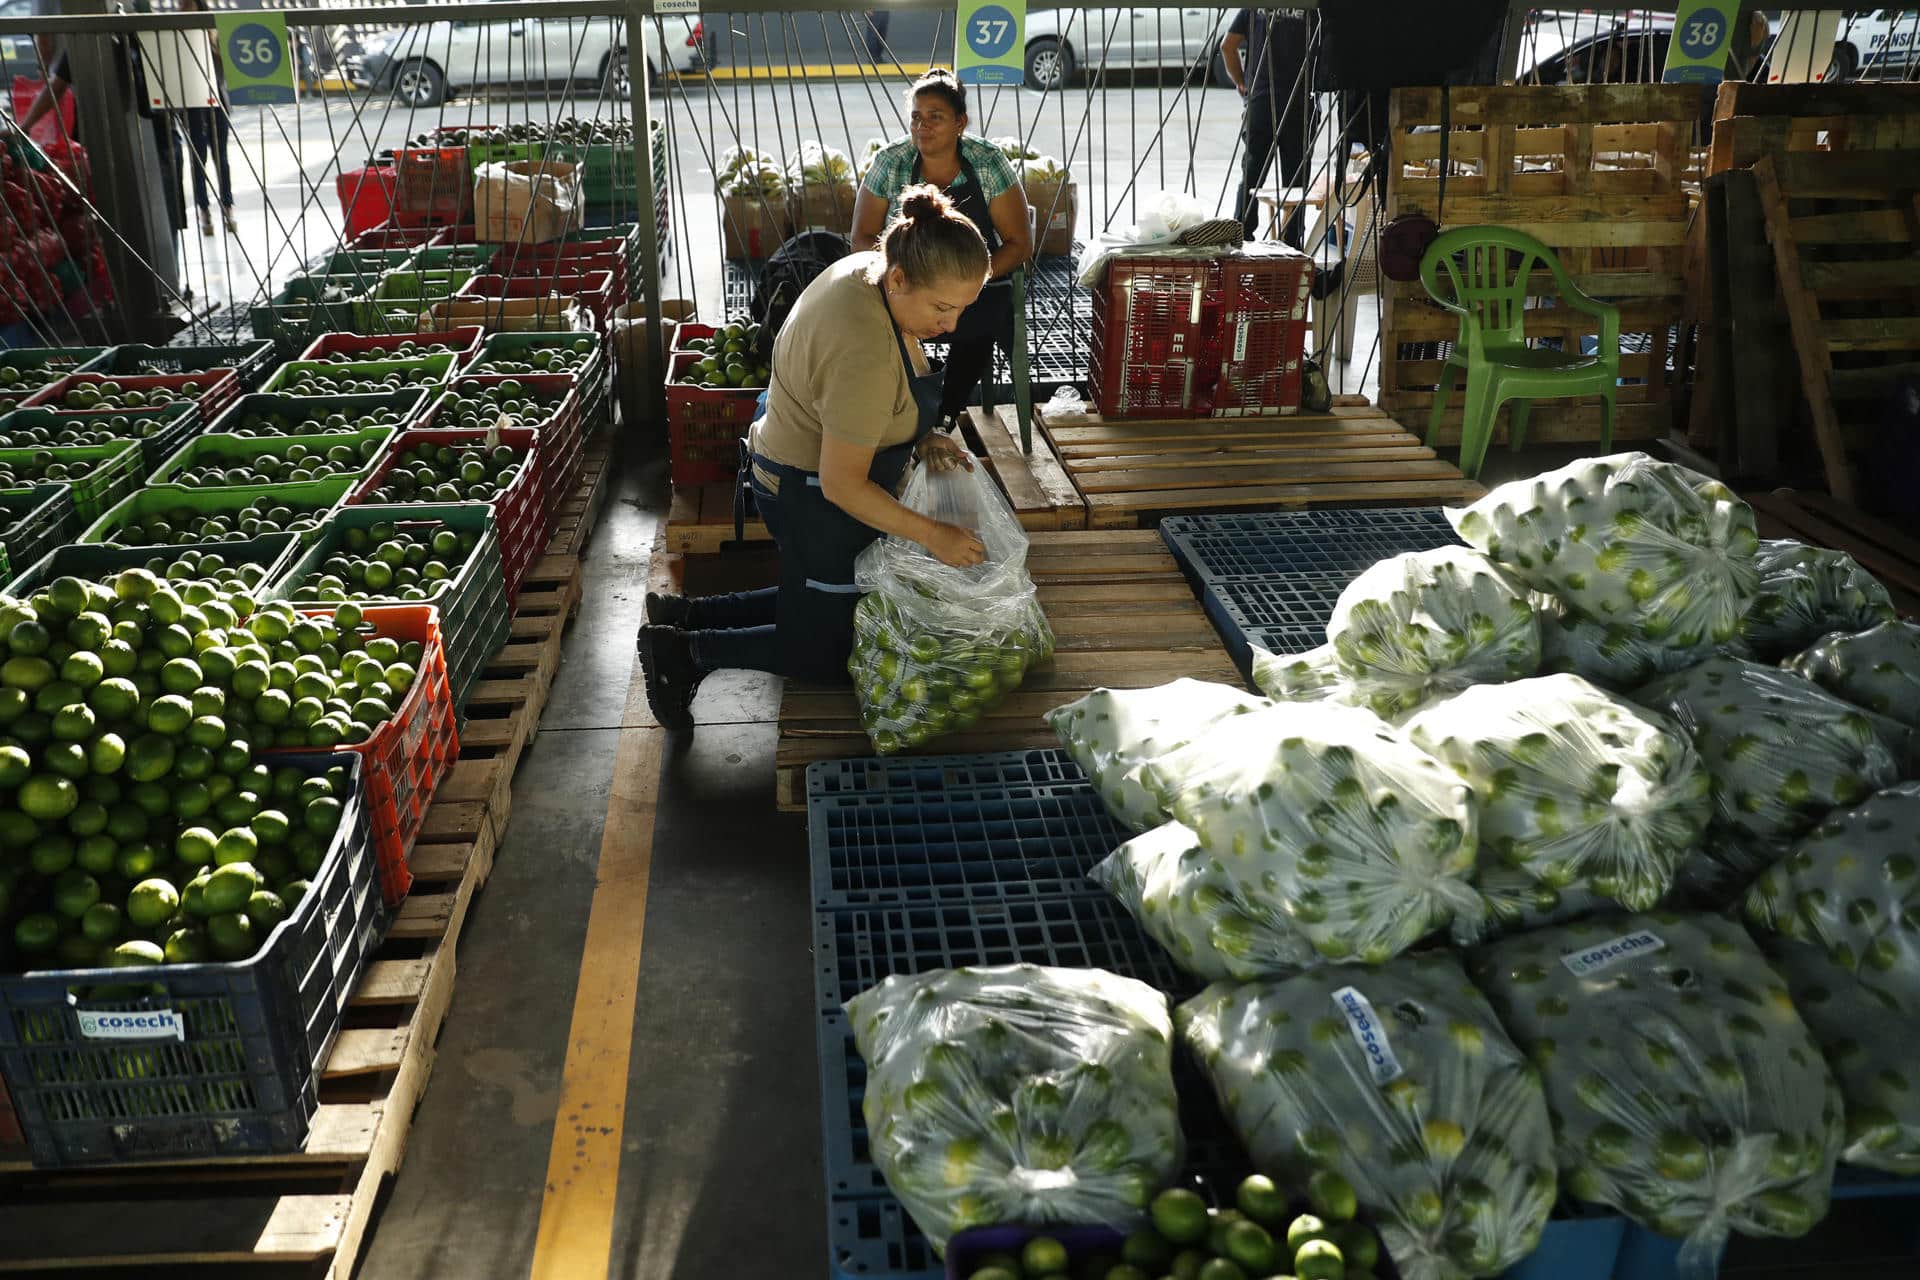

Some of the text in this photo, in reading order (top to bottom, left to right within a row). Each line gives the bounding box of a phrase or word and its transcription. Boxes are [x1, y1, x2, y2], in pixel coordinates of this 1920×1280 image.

[976, 20, 1008, 45] 37
[1686, 22, 1719, 46] 38
[1869, 32, 1914, 48] PRNSA
[237, 38, 273, 64] 36
[1236, 322, 1246, 353] cosech
[1581, 935, 1655, 964] cosecha
[98, 1013, 176, 1029] cosech
[1342, 992, 1384, 1065] cosecha
